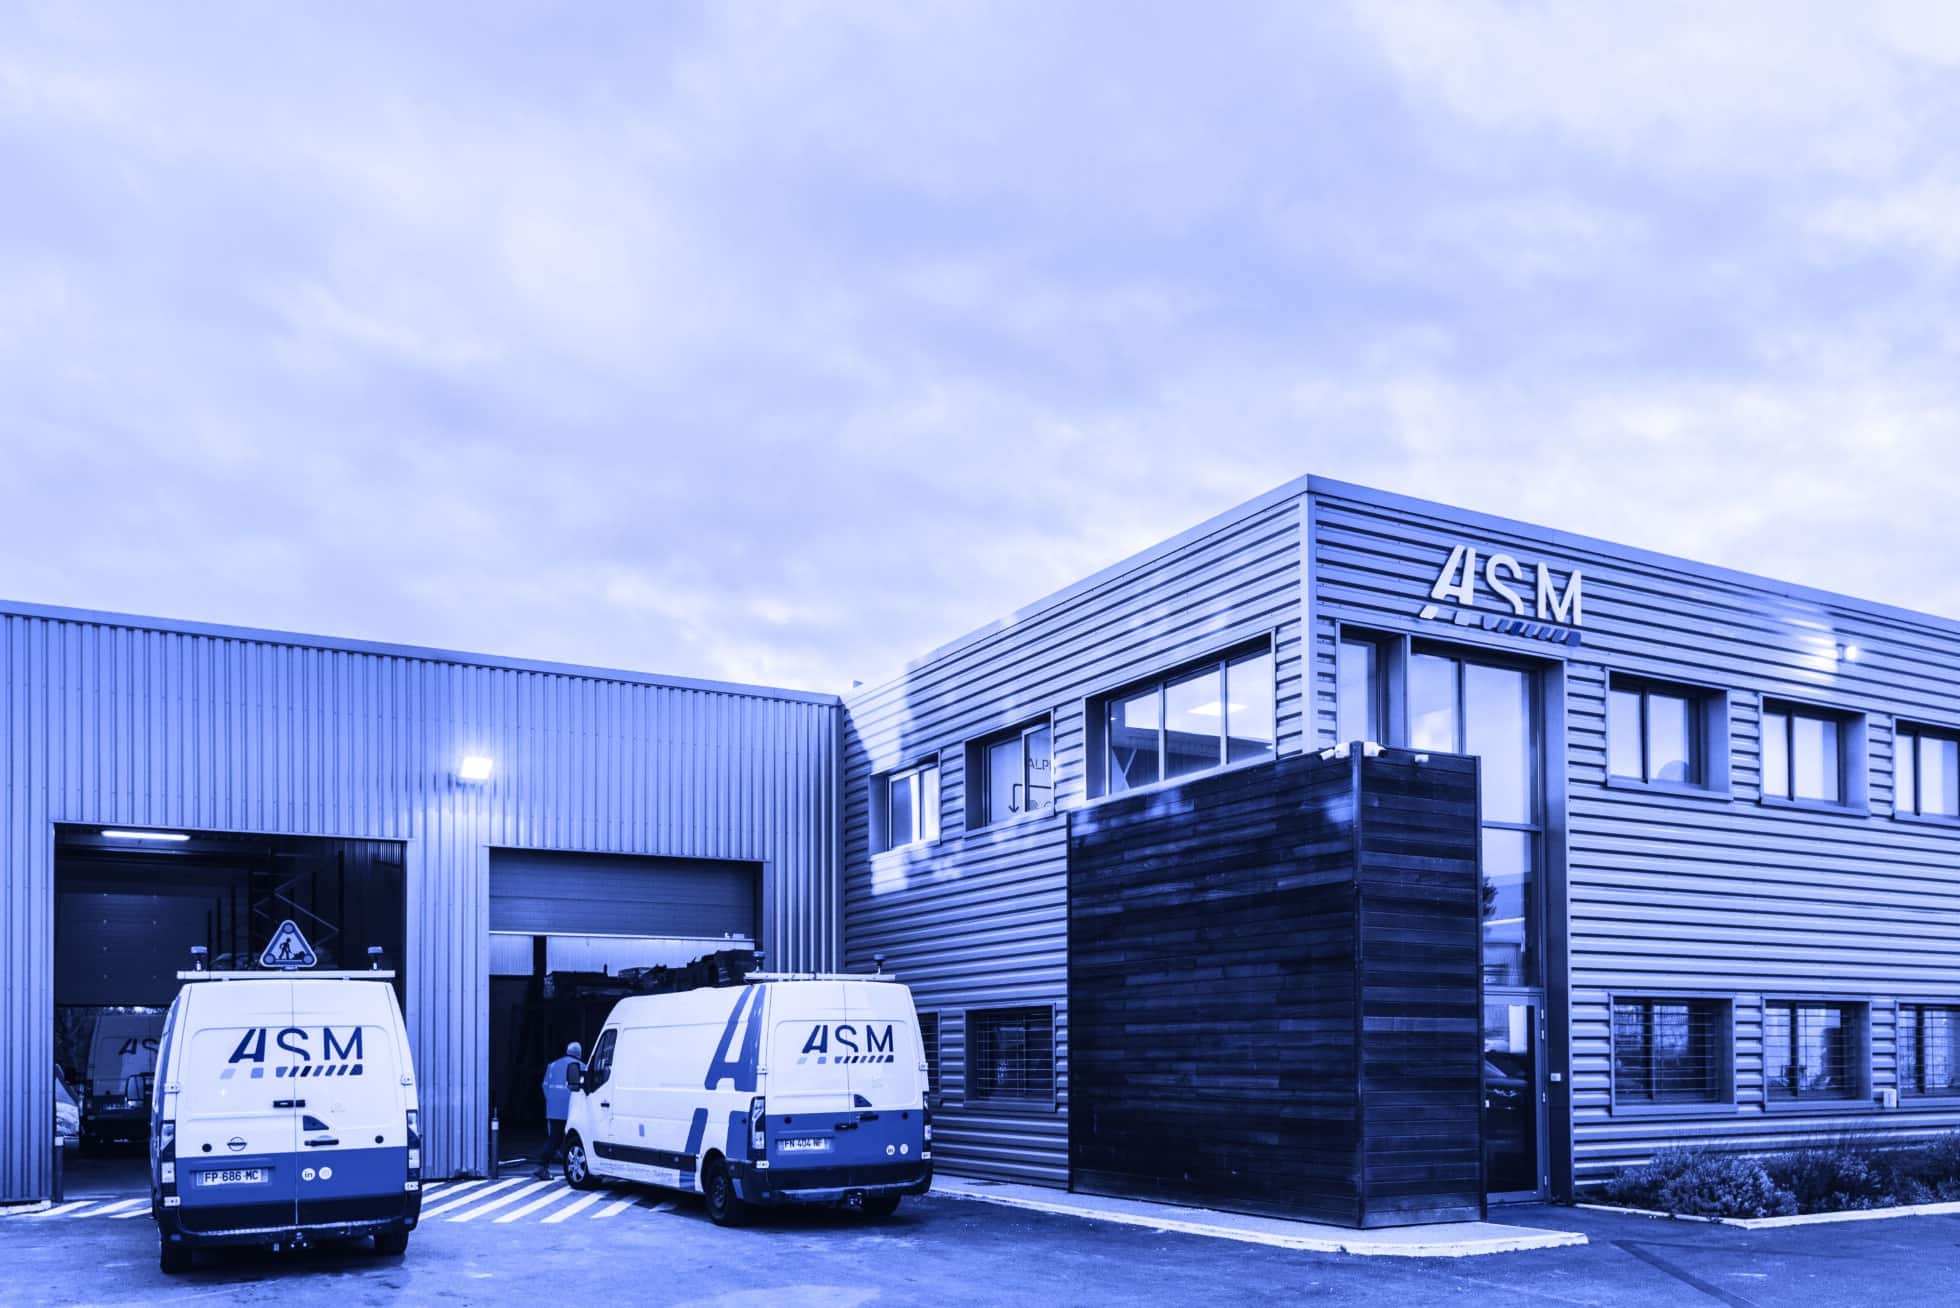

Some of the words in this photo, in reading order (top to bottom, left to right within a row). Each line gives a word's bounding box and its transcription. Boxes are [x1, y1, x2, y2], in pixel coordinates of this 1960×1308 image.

[1431, 543, 1583, 626] ASM
[118, 1038, 160, 1055] AS
[228, 1026, 363, 1063] ASM
[802, 1024, 894, 1054] ASM
